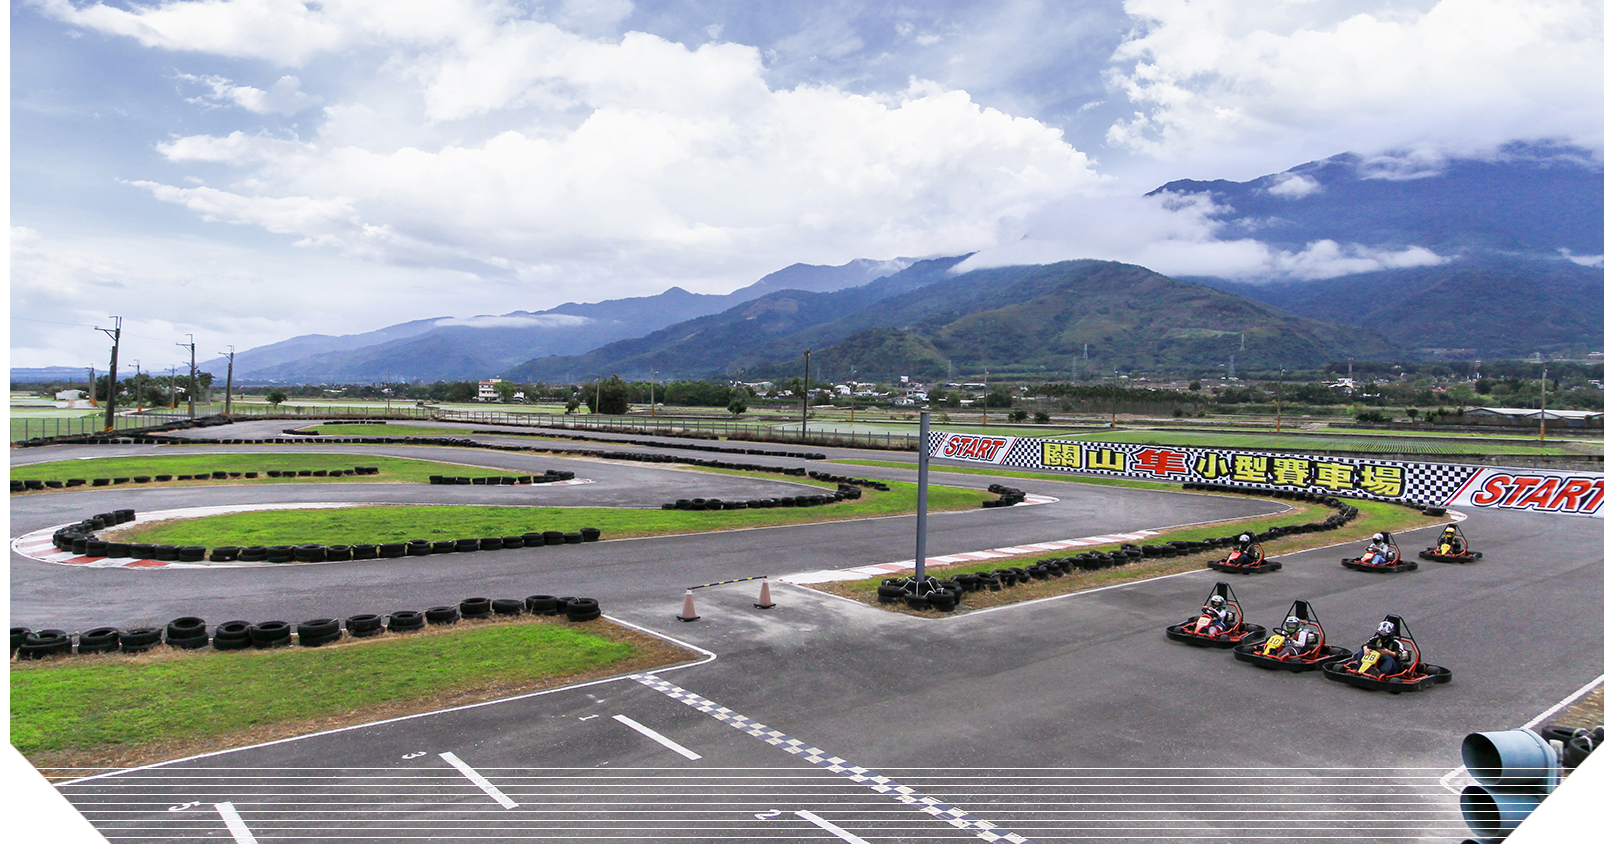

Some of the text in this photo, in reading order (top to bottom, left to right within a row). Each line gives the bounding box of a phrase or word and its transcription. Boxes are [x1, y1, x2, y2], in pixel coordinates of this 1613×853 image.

[944, 435, 1006, 462] START
[1042, 441, 1402, 496] 關山隼小型賽車場
[1474, 473, 1613, 511] START
[401, 751, 427, 760] 3
[168, 800, 200, 811] 5
[754, 809, 782, 820] 2
